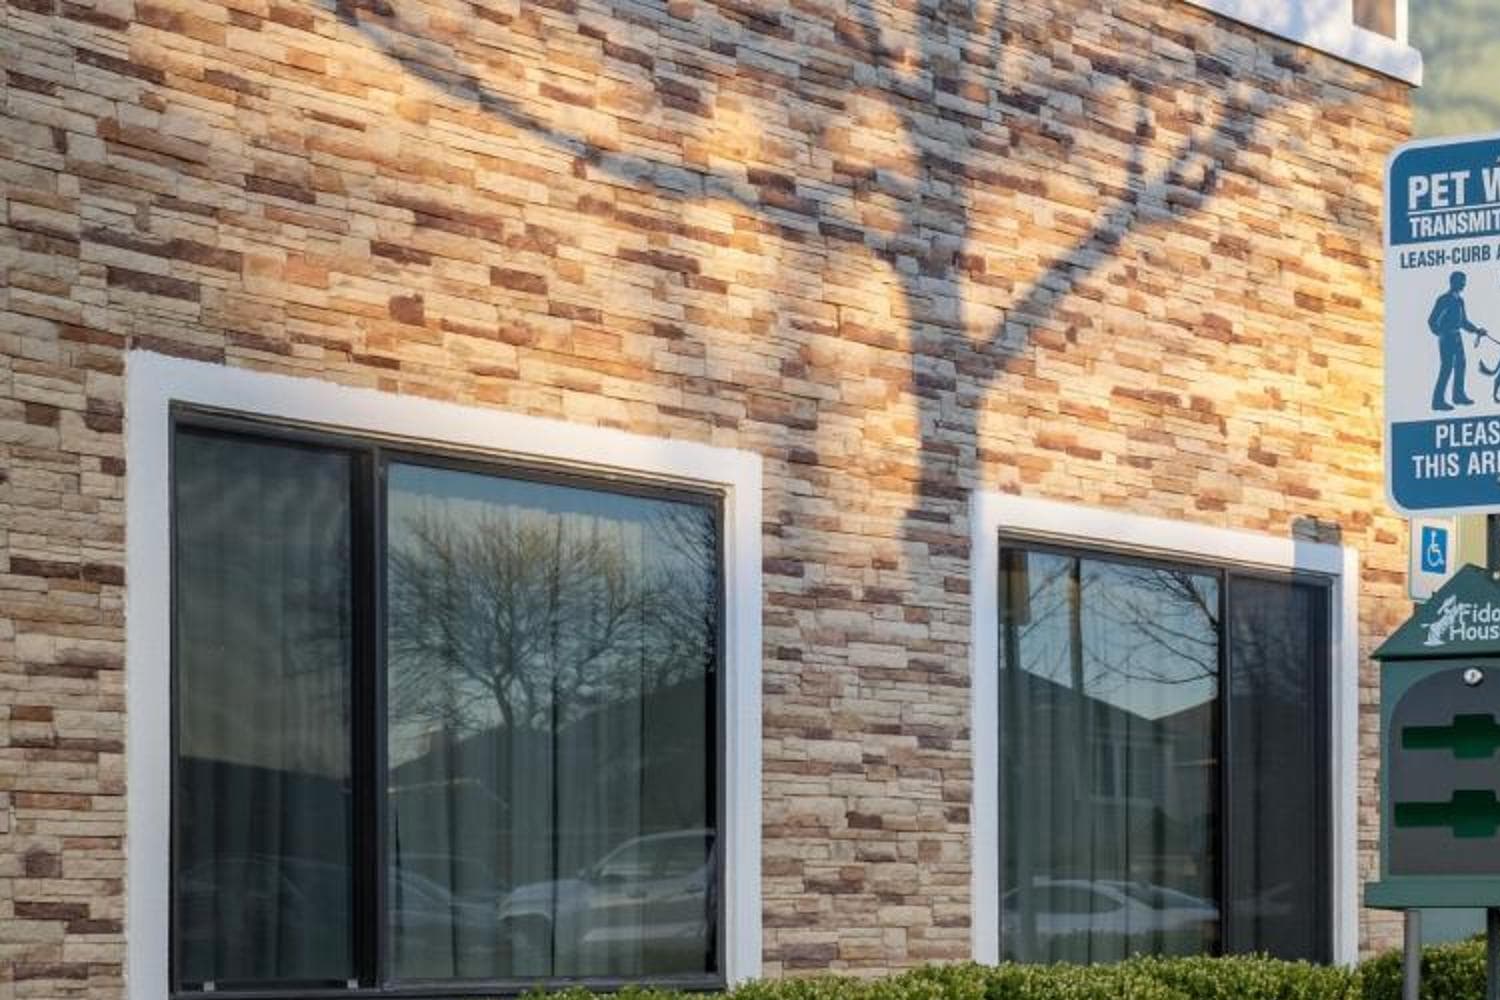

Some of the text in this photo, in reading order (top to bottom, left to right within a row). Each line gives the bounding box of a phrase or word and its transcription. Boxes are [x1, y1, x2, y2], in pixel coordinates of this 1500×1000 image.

[1407, 170, 1470, 210] PET
[1400, 244, 1491, 269] LEASH-CURB
[1412, 454, 1460, 479] THIS
